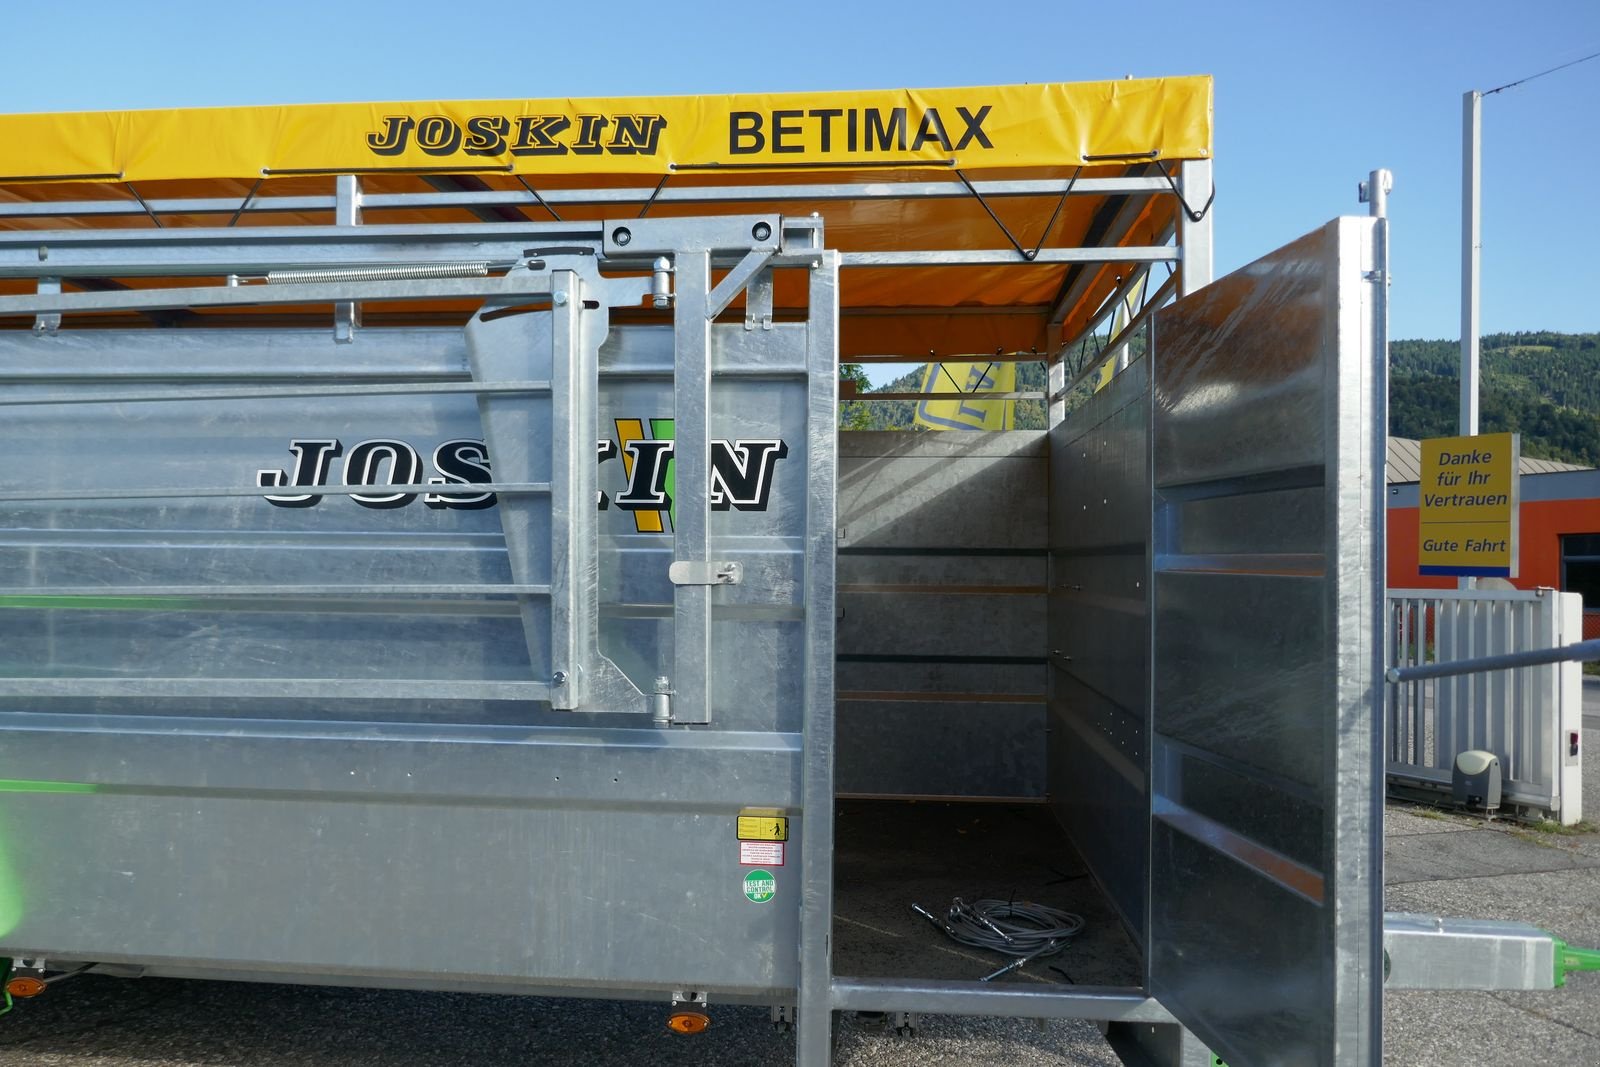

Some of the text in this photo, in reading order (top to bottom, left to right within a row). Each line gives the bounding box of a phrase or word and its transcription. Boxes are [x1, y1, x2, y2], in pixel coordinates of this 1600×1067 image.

[366, 105, 994, 156] JOSKIN BETIMAX
[1438, 449, 1492, 466] Danke
[256, 438, 788, 512] JOSIN
[1437, 470, 1492, 486] für Ihr
[1424, 493, 1508, 507] Vertrauen
[1423, 538, 1507, 553] Gute Fahrt
